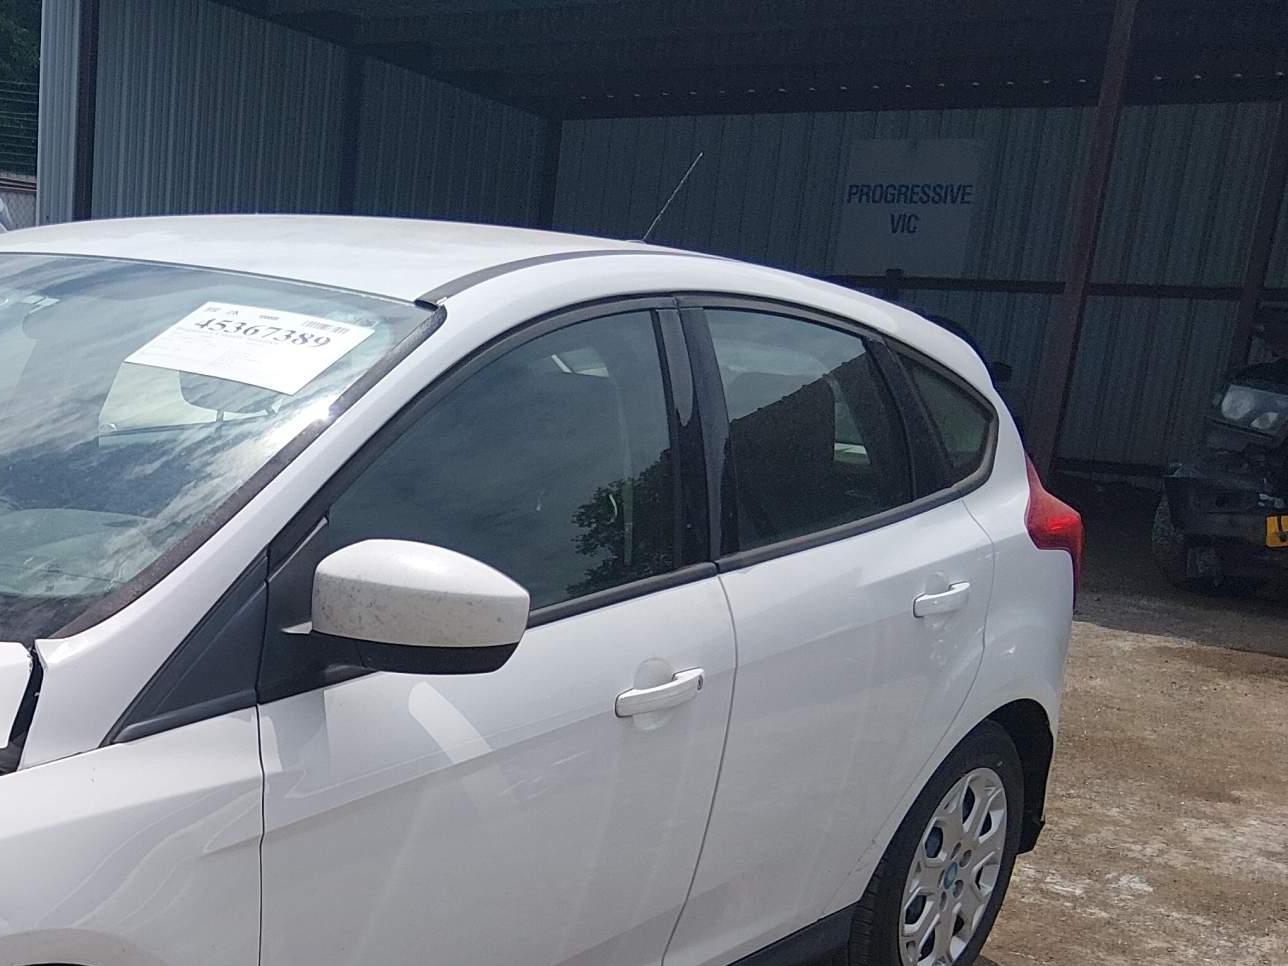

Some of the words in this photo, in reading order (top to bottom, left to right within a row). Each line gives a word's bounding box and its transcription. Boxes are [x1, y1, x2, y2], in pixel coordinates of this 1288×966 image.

[847, 184, 973, 204] PROGRESSIVE
[890, 213, 920, 234] VIC
[194, 318, 332, 348] 45367389
